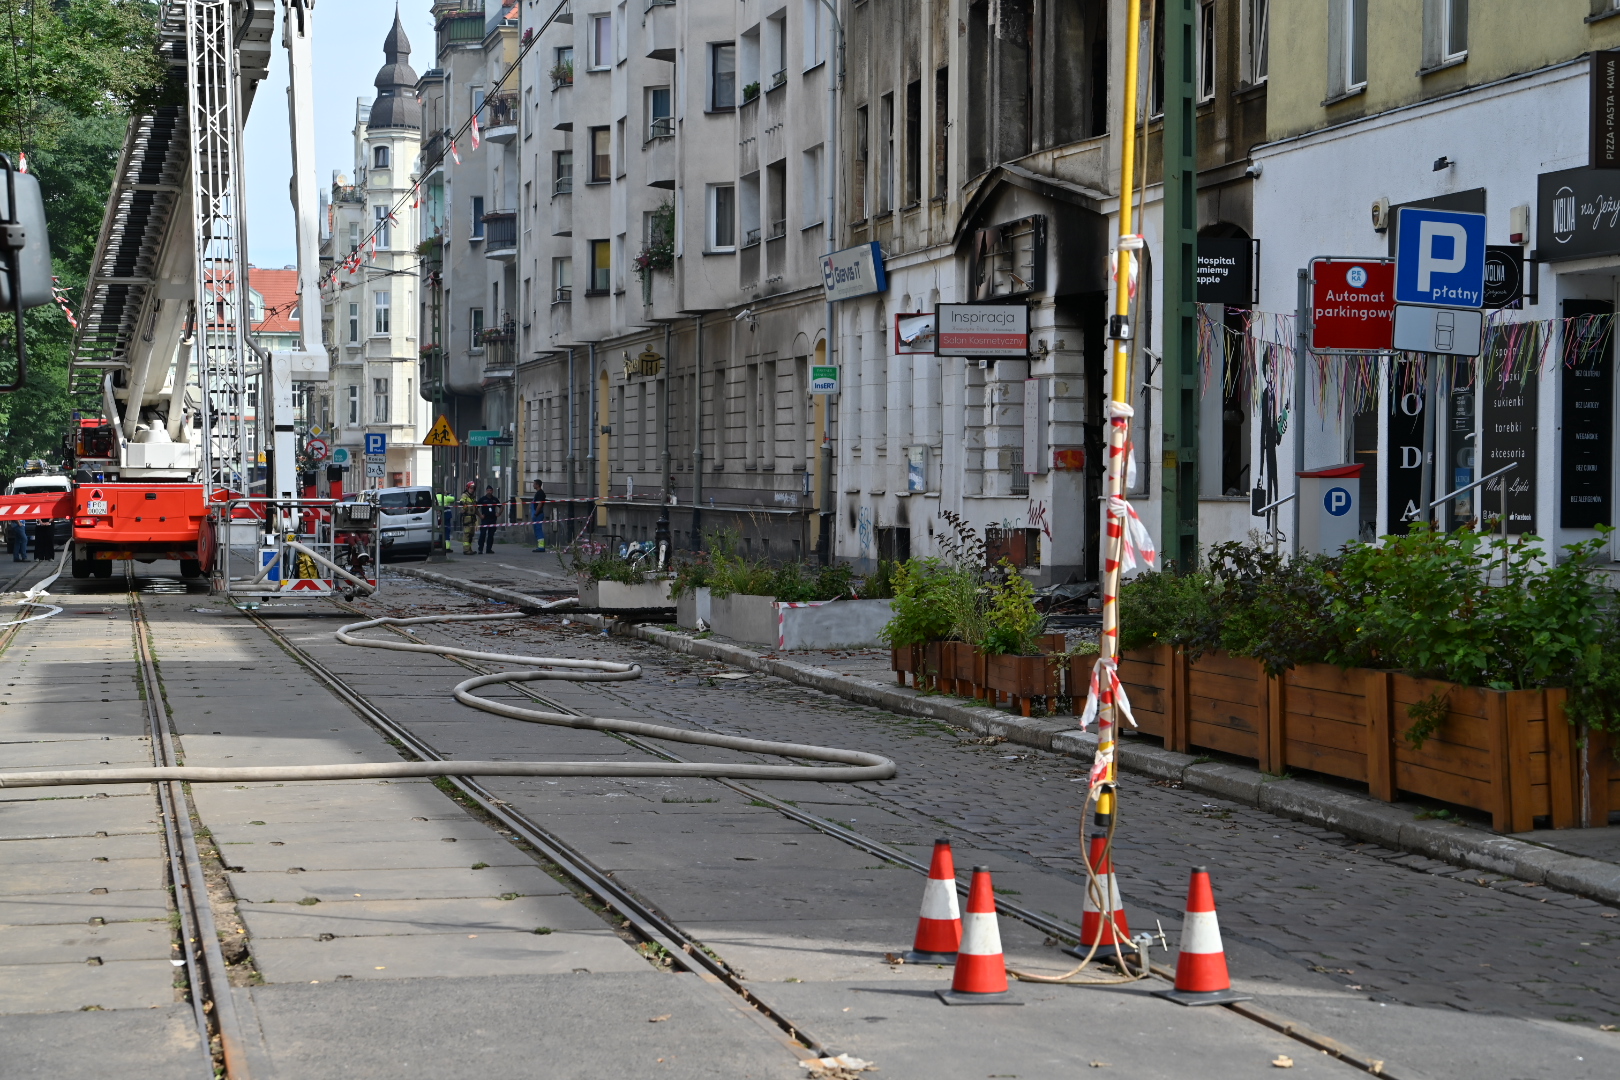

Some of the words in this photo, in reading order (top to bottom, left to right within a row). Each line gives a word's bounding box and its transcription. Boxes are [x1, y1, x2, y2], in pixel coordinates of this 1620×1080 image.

[1606, 60, 1616, 90] KAWA
[1606, 96, 1616, 126] PASTA
[1606, 131, 1616, 160] PIZZA
[1553, 196, 1576, 234] WOLNA
[1197, 256, 1236, 267] Hospital
[1417, 220, 1468, 293] P
[1325, 289, 1385, 303] Automat
[1432, 285, 1479, 304] płatny
[951, 310, 1015, 326] Inspiracja
[1315, 305, 1394, 321] parkingowy
[943, 335, 967, 345] Salon
[969, 336, 1024, 347] Kosmetyczny
[1493, 396, 1524, 408] sukienki
[1495, 421, 1522, 433] torebki
[369, 436, 382, 452] P
[1490, 447, 1526, 458] akcesoria
[1331, 491, 1346, 512] P
